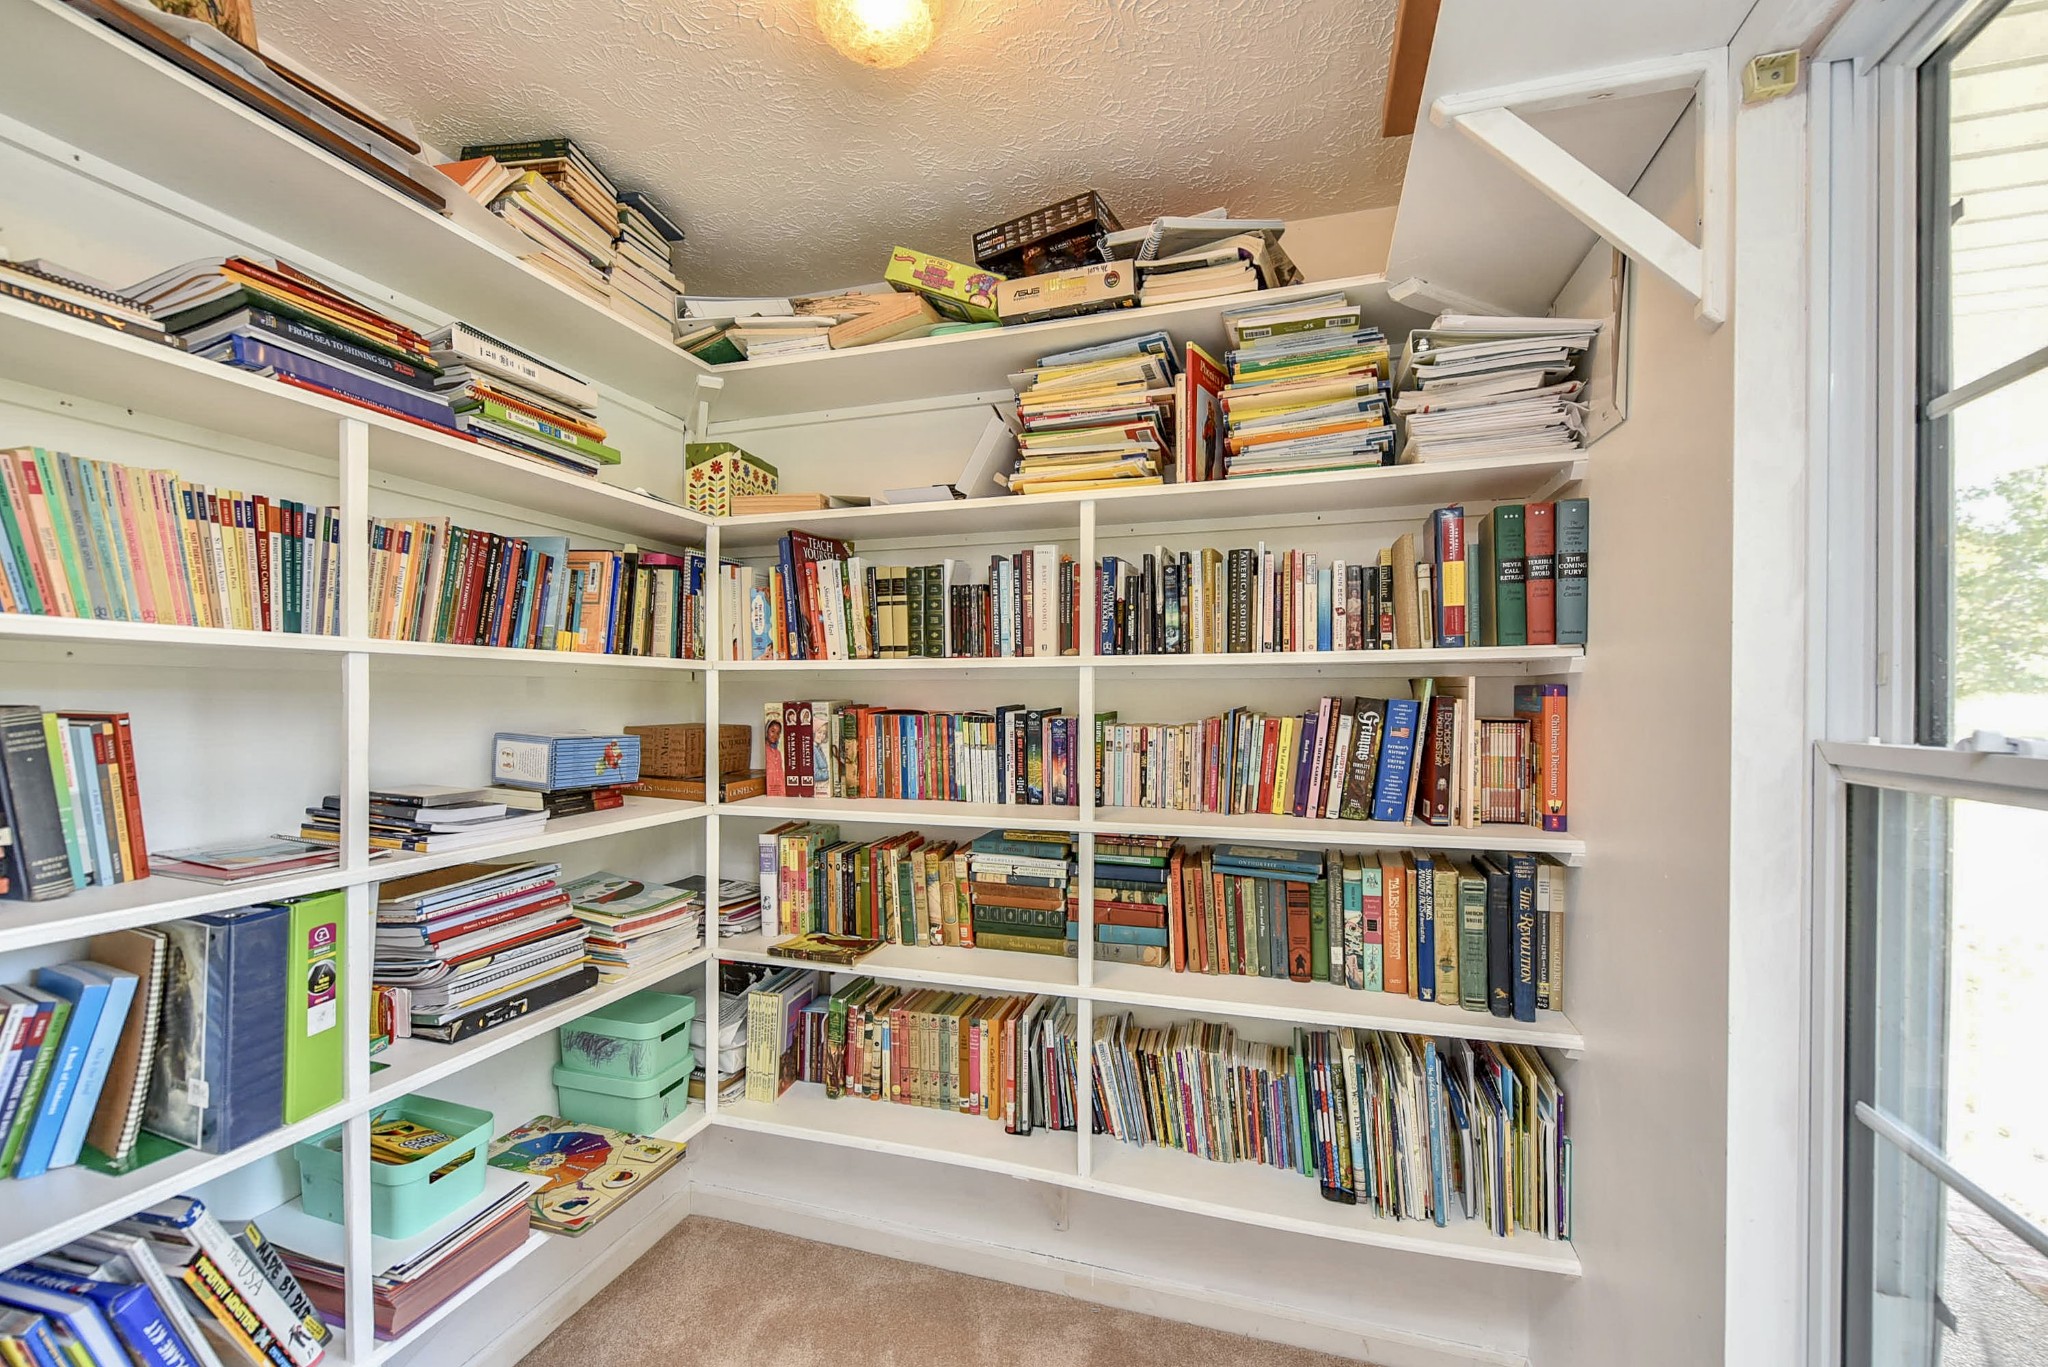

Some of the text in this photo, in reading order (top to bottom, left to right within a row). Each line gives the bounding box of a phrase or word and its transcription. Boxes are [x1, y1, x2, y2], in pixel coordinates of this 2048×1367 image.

[976, 228, 998, 240] GIGABYTE
[37, 296, 97, 320] MYTHS
[1013, 287, 1040, 298] ASUS
[287, 324, 393, 369] FROM SEA TO SHINING SEA
[808, 537, 833, 552] TEACH
[260, 538, 270, 604] EDMUND CAMPION
[516, 568, 524, 593] VICTORY
[784, 564, 794, 622] Organizational Behavior
[1381, 566, 1392, 598] malone
[1339, 745, 1347, 770] GULLIVER'S
[1434, 711, 1444, 766] WORLD HISTORY
[1443, 712, 1452, 766] ENCYCLOPEDIA
[1549, 714, 1561, 798] Children's Dictionary
[122, 740, 137, 796] Beorn the Proud
[1418, 868, 1426, 895] AMAZING
[1388, 878, 1400, 960] TALES of the WEST
[1516, 886, 1534, 984] THE REVOLUTION
[195, 1254, 261, 1336] PAPERTOY MONSTERS
[226, 1246, 264, 1297] The USA
[255, 1240, 312, 1322] MADE BY DAD
